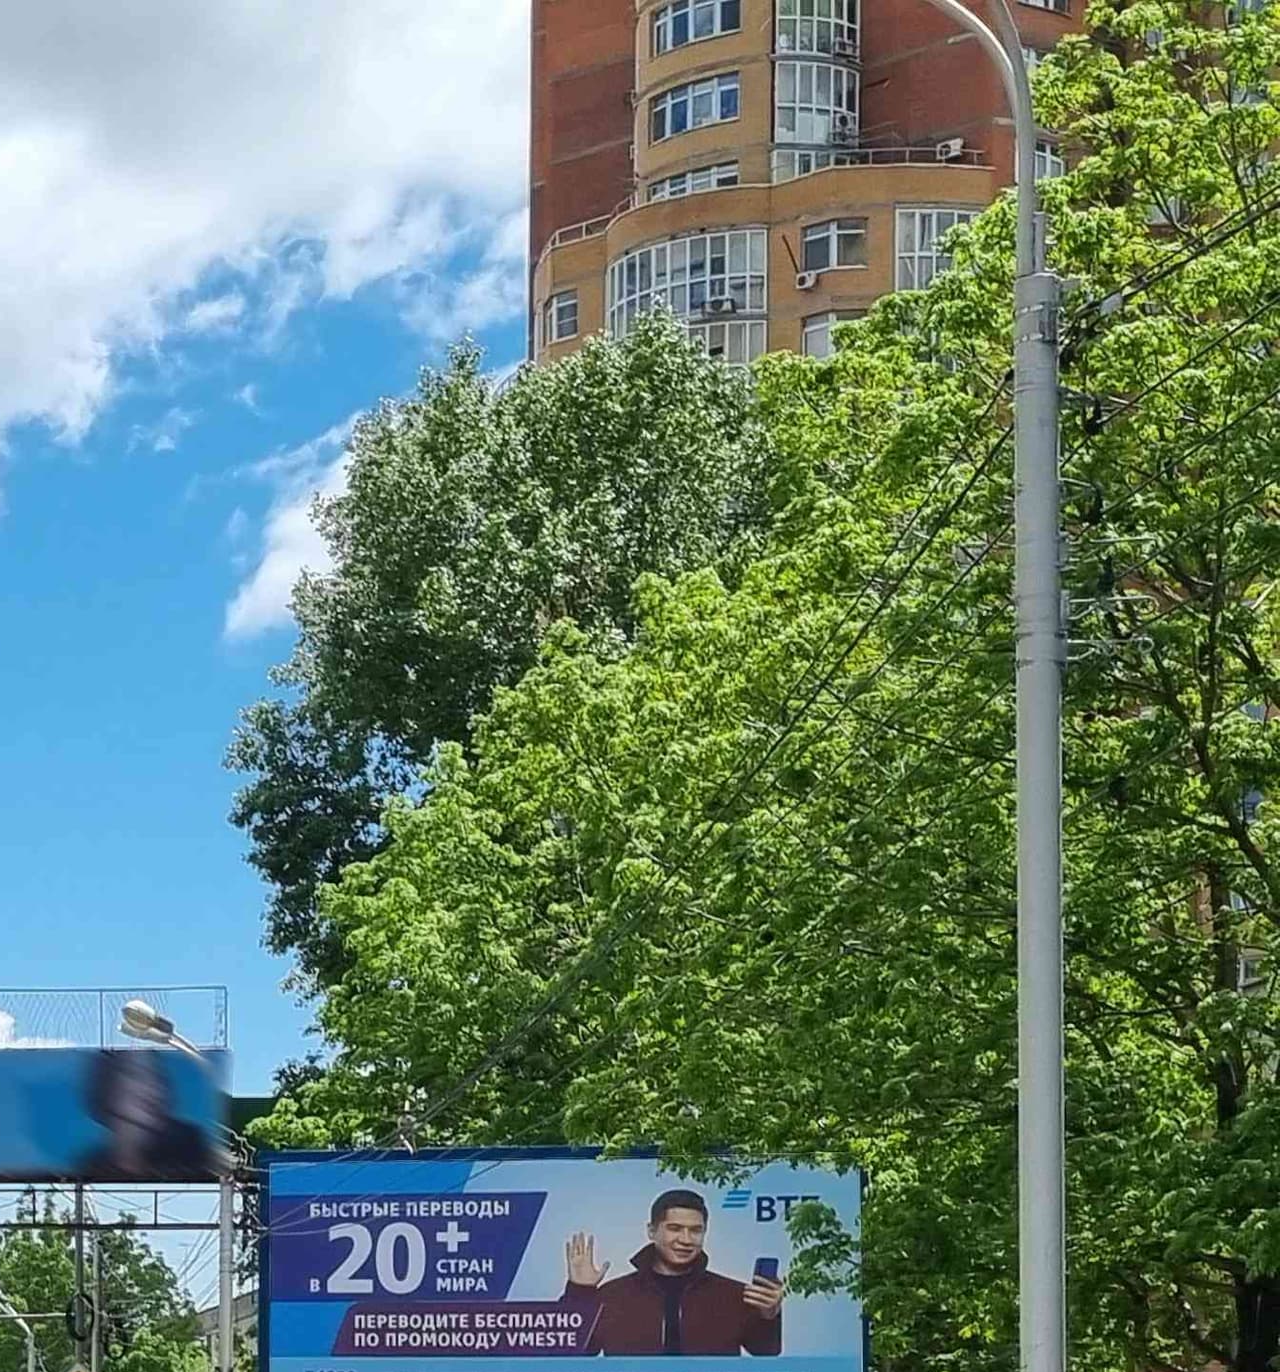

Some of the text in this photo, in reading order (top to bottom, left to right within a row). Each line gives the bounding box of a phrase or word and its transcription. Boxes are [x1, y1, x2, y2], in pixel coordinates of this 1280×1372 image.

[309, 1200, 510, 1219] БЫСТРЫЕ ПЕРЕВОДЫ
[756, 1195, 821, 1222] ВТ
[436, 1259, 494, 1274] СТРАН
[436, 1277, 489, 1292] МИРА
[354, 1312, 583, 1331] ПЕРЕВОДИТЕ БЕСПЛАТНО
[354, 1332, 577, 1349] ПО ПРОМОКОДУ VMESTE
